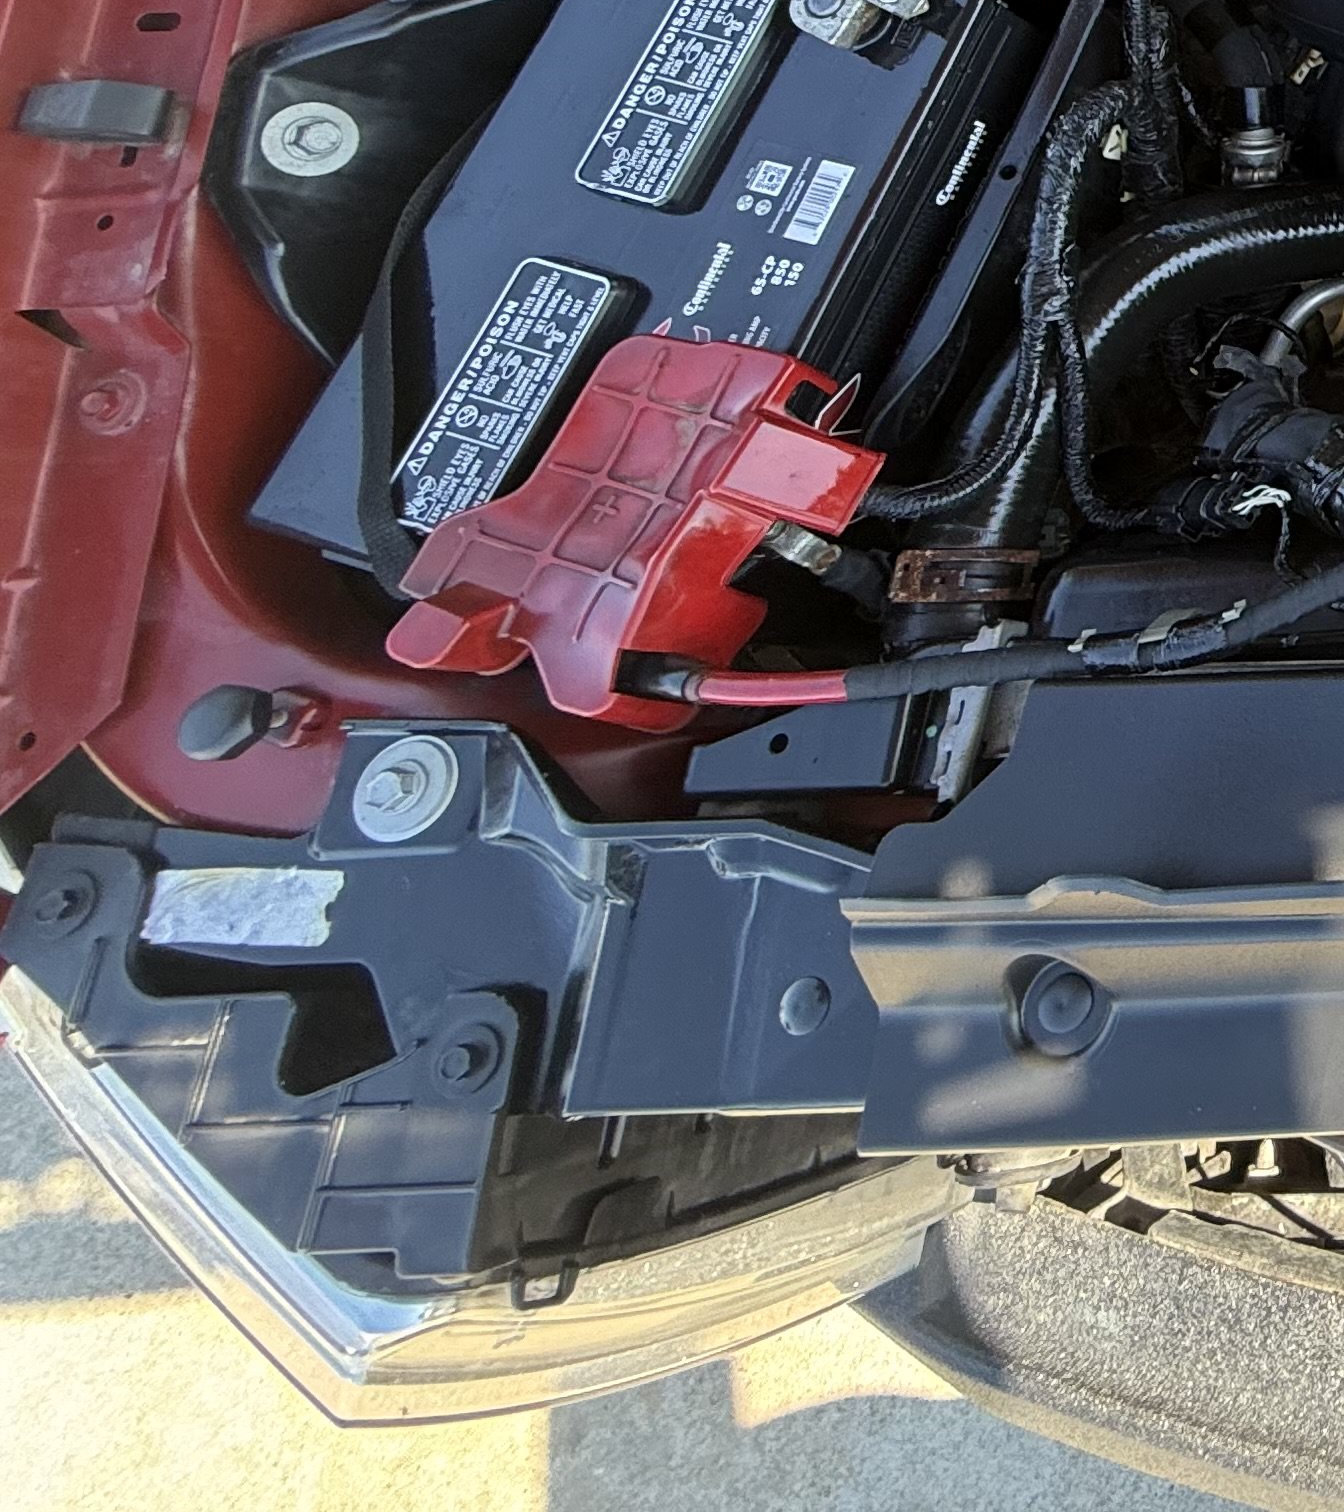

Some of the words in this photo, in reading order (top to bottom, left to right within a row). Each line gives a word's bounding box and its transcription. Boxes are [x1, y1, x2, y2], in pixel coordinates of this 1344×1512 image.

[686, 8, 704, 29] FLUSH
[712, 10, 726, 23] GET
[669, 59, 684, 77] ACID
[664, 94, 676, 105] NO
[624, 148, 653, 188] EXPLOSIVE
[648, 121, 669, 146] GASES
[626, 139, 649, 167] SHIELD
[642, 118, 660, 138] EYES
[936, 120, 985, 205] Continental
[683, 242, 731, 316] Continental
[748, 316, 761, 332] AMP
[770, 259, 790, 285] 850
[751, 255, 776, 295] 65-CP
[504, 316, 524, 340] FLUSH
[518, 296, 536, 315] EYES
[530, 276, 548, 294] WITH
[514, 318, 534, 342] WATER
[529, 271, 561, 317] IMMEDIATELY
[532, 318, 547, 333] GET
[542, 288, 566, 318] MEDICAL
[557, 294, 573, 315] HELP
[568, 299, 585, 318] FAST
[755, 326, 771, 347] ACITY
[784, 262, 804, 286] 150
[418, 297, 519, 455] DANGER/POISON
[473, 352, 503, 392] SULFURIC
[483, 374, 500, 395] ACID
[476, 415, 489, 428] NO
[479, 412, 501, 440] SPARKS
[488, 414, 509, 443] FLAMES
[427, 476, 461, 524] EXPLOSIVE
[457, 446, 479, 474] GASES
[432, 467, 456, 498] SHIELD
[450, 443, 470, 465] EYES
